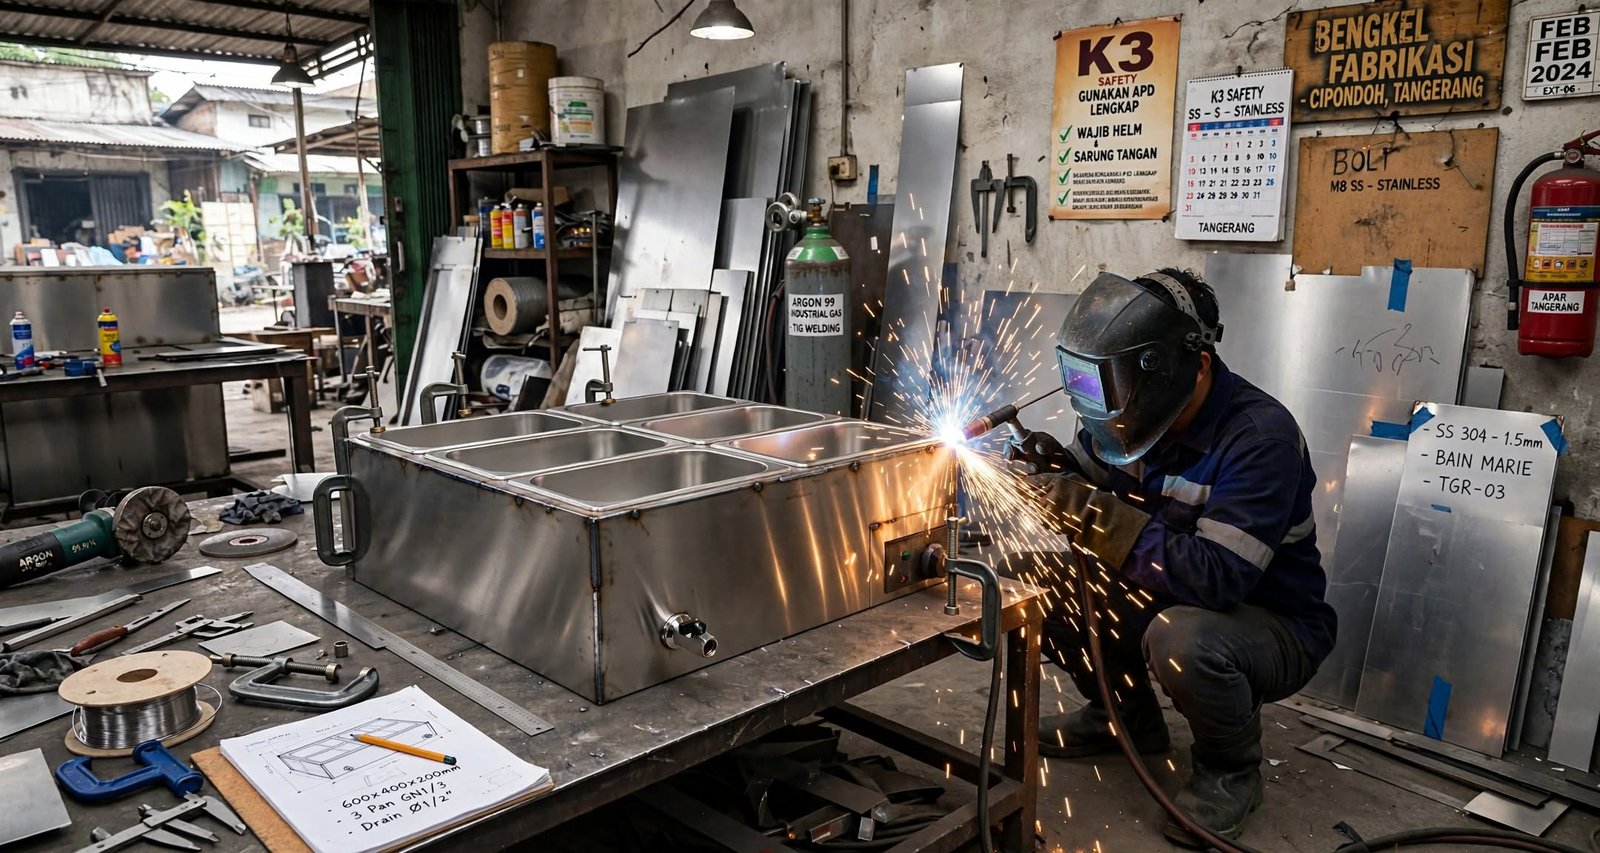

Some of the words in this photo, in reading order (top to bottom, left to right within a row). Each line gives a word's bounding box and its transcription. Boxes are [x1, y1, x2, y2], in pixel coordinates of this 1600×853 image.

[1315, 8, 1429, 53] BENGKEL
[1540, 17, 1590, 39] FEB
[1078, 30, 1154, 77] K3
[1536, 38, 1590, 63] FEB
[1329, 40, 1474, 84] FABRIKASI
[1098, 73, 1138, 87] SAFETY
[1531, 60, 1592, 83] 2024
[1079, 87, 1130, 102] GUNAKAN
[1132, 84, 1155, 97] APD
[1211, 90, 1224, 103] K3
[1227, 86, 1264, 101] SAFETY
[1310, 83, 1389, 109] CIPONDOH,
[1393, 75, 1484, 103] TANGERANG
[1543, 85, 1576, 95] EXT-06
[1090, 100, 1139, 115] LENGKAP
[1189, 108, 1200, 119] SS
[1215, 107, 1220, 118] S
[1234, 102, 1284, 117] STAINLESS
[1078, 126, 1109, 139] WAJIB
[1113, 123, 1142, 136] HELM
[1074, 150, 1113, 162] SARUNG
[1117, 147, 1157, 160] TANGAN
[1269, 152, 1277, 160] 10
[1333, 148, 1391, 175] BOLT
[1232, 166, 1240, 174] 15
[1243, 166, 1252, 174] 16
[1255, 165, 1263, 173] 17
[1331, 180, 1347, 192] M8
[1351, 180, 1363, 191] SS
[1377, 177, 1440, 191] STAINLESS
[1199, 223, 1254, 233] TANGERANG
[792, 298, 821, 307] ARGON
[825, 298, 835, 307] 99
[1542, 293, 1566, 301] APAR
[830, 309, 841, 317] GAS
[1532, 302, 1579, 311] TANGERANG
[793, 323, 803, 332] TIG
[805, 323, 840, 333] WELDING
[1436, 423, 1454, 438] SS
[1461, 427, 1486, 443] 304
[1505, 432, 1542, 448] 1.5mm
[1436, 450, 1472, 468] BAIN
[1481, 456, 1532, 476] MARIE
[1440, 476, 1505, 499] TGR-03
[367, 800, 395, 813] Pan
[400, 781, 447, 802] GN1/3
[361, 811, 402, 831] Drain
